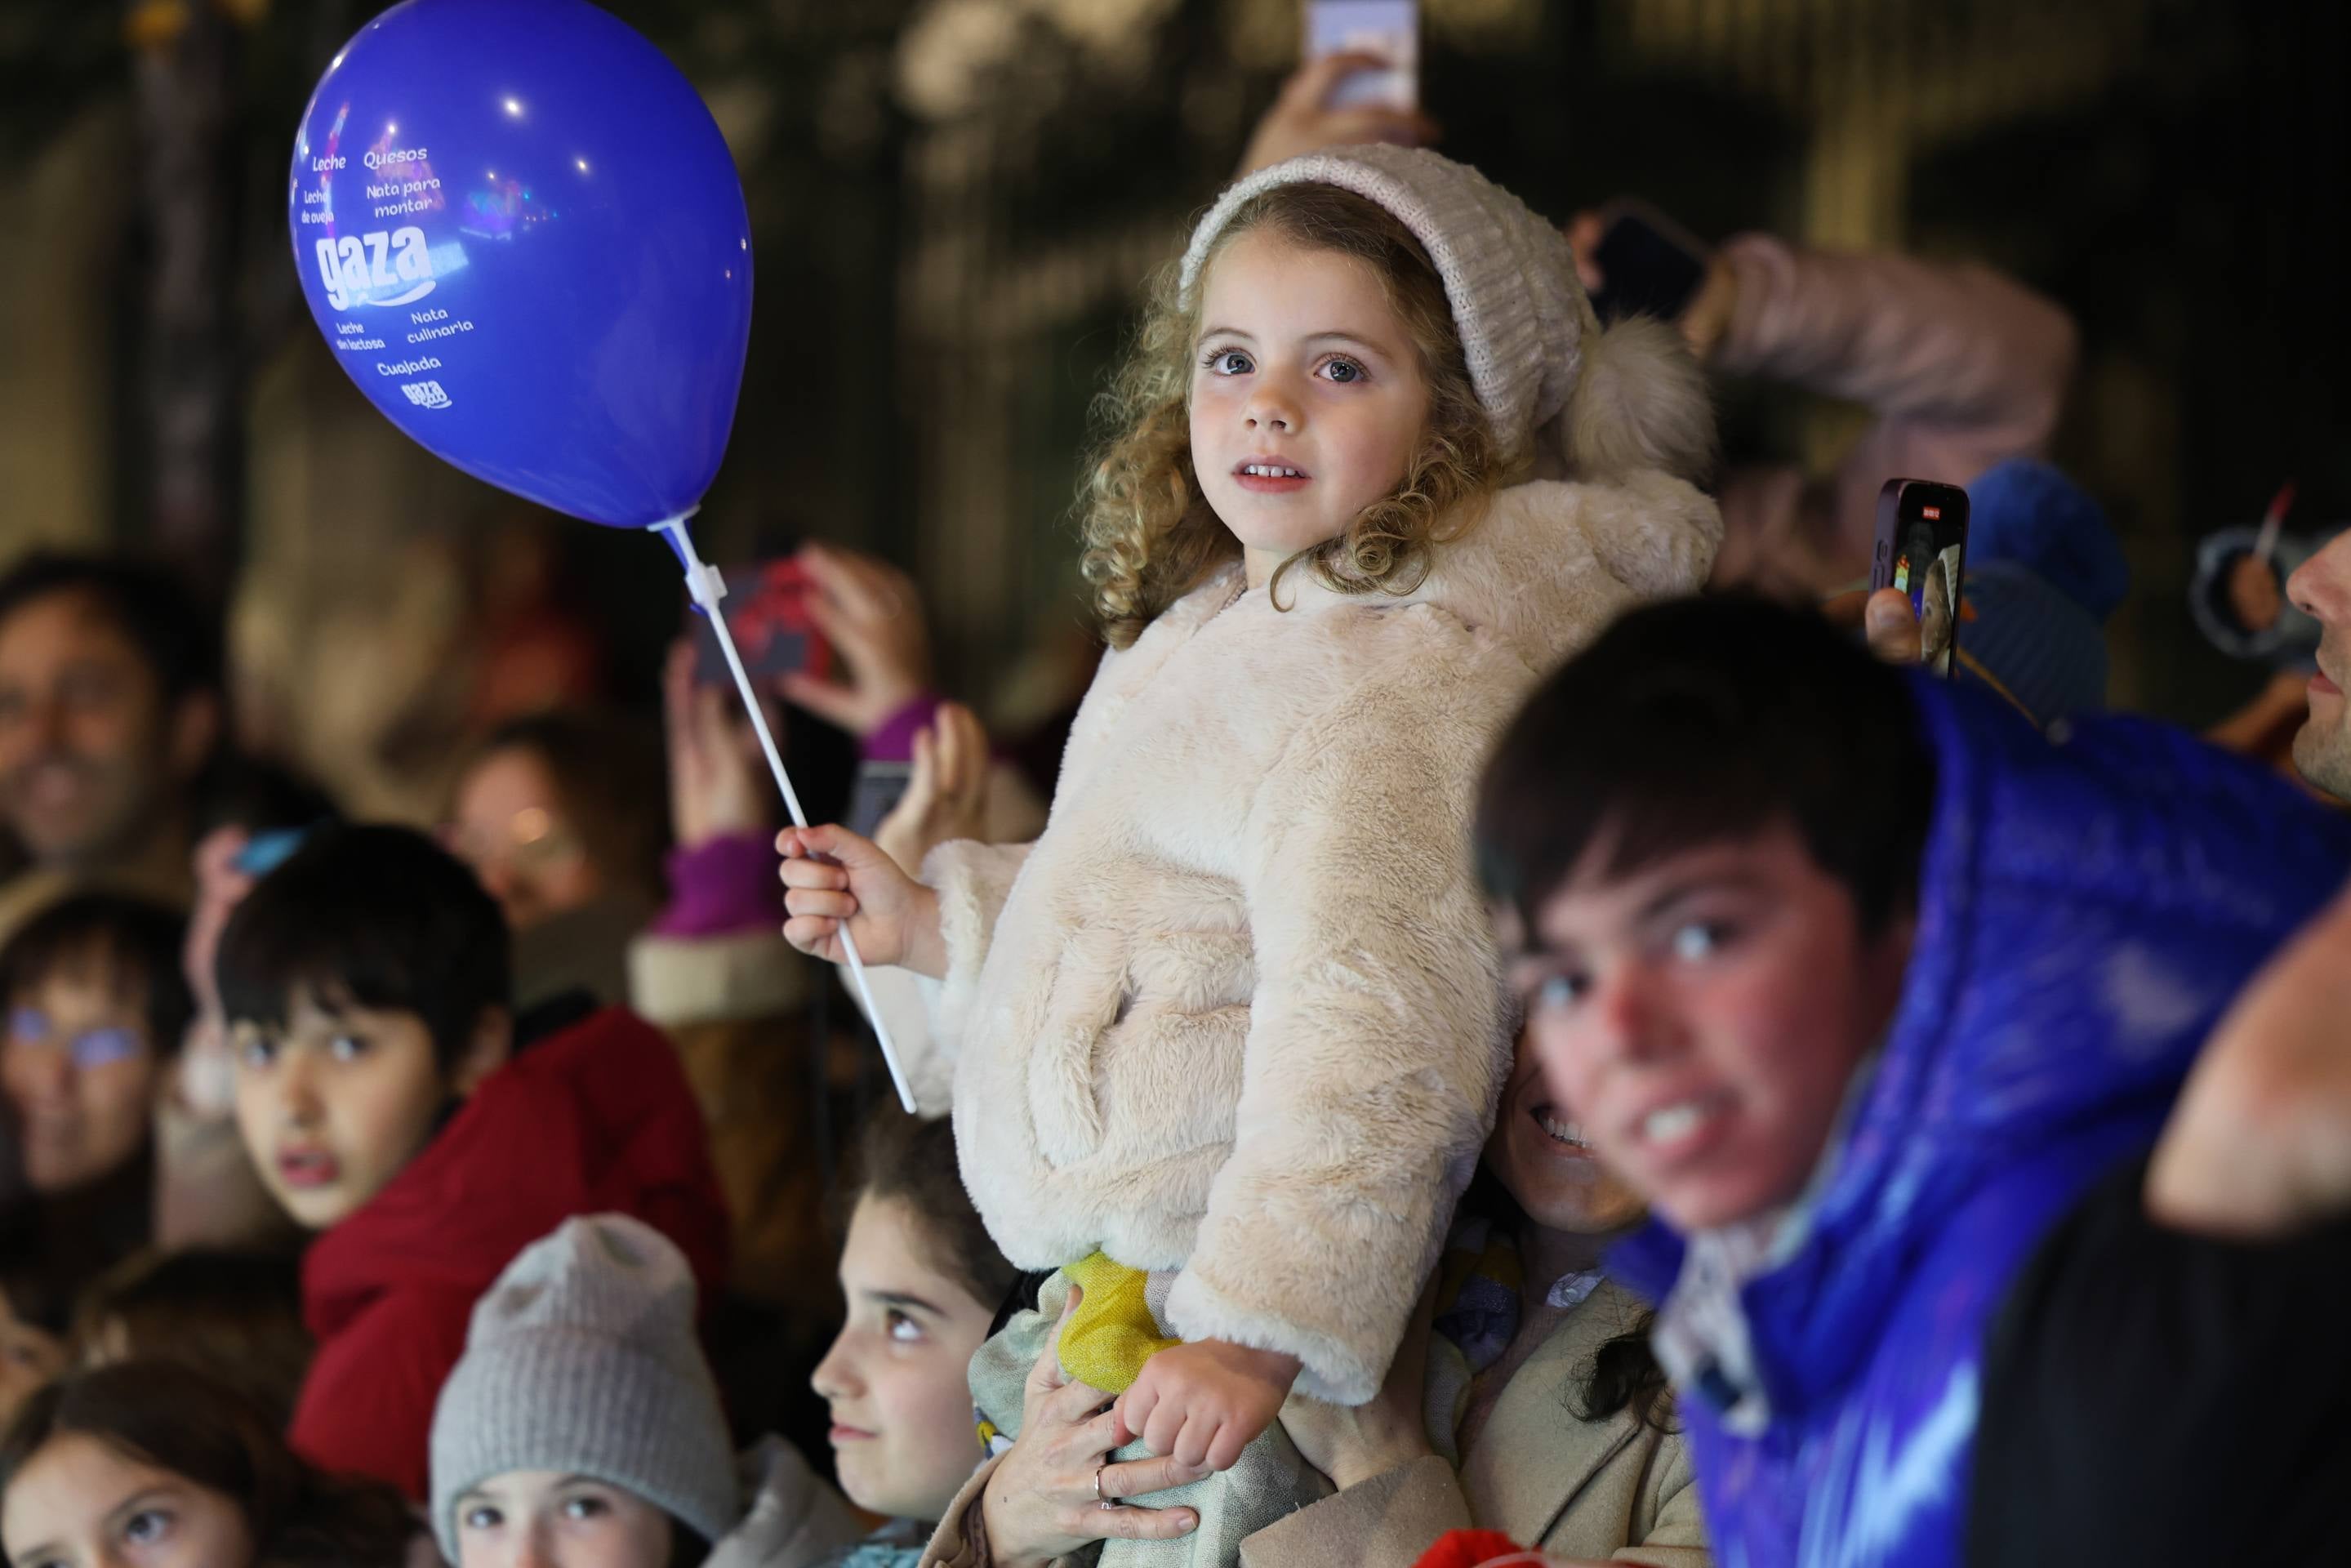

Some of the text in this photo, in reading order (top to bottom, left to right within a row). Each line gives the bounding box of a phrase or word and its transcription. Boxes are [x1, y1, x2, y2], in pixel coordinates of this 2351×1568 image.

[313, 154, 346, 172] Leche
[364, 148, 428, 170] Quesos
[367, 177, 441, 199] Nata para
[301, 209, 335, 225] de oveja
[375, 198, 434, 218] montar
[316, 226, 433, 311] gaza
[411, 309, 449, 325] Nata
[336, 322, 365, 335] Leche
[407, 320, 474, 344] culinaria
[350, 337, 386, 351] lactosa
[376, 356, 442, 376] Cuajada
